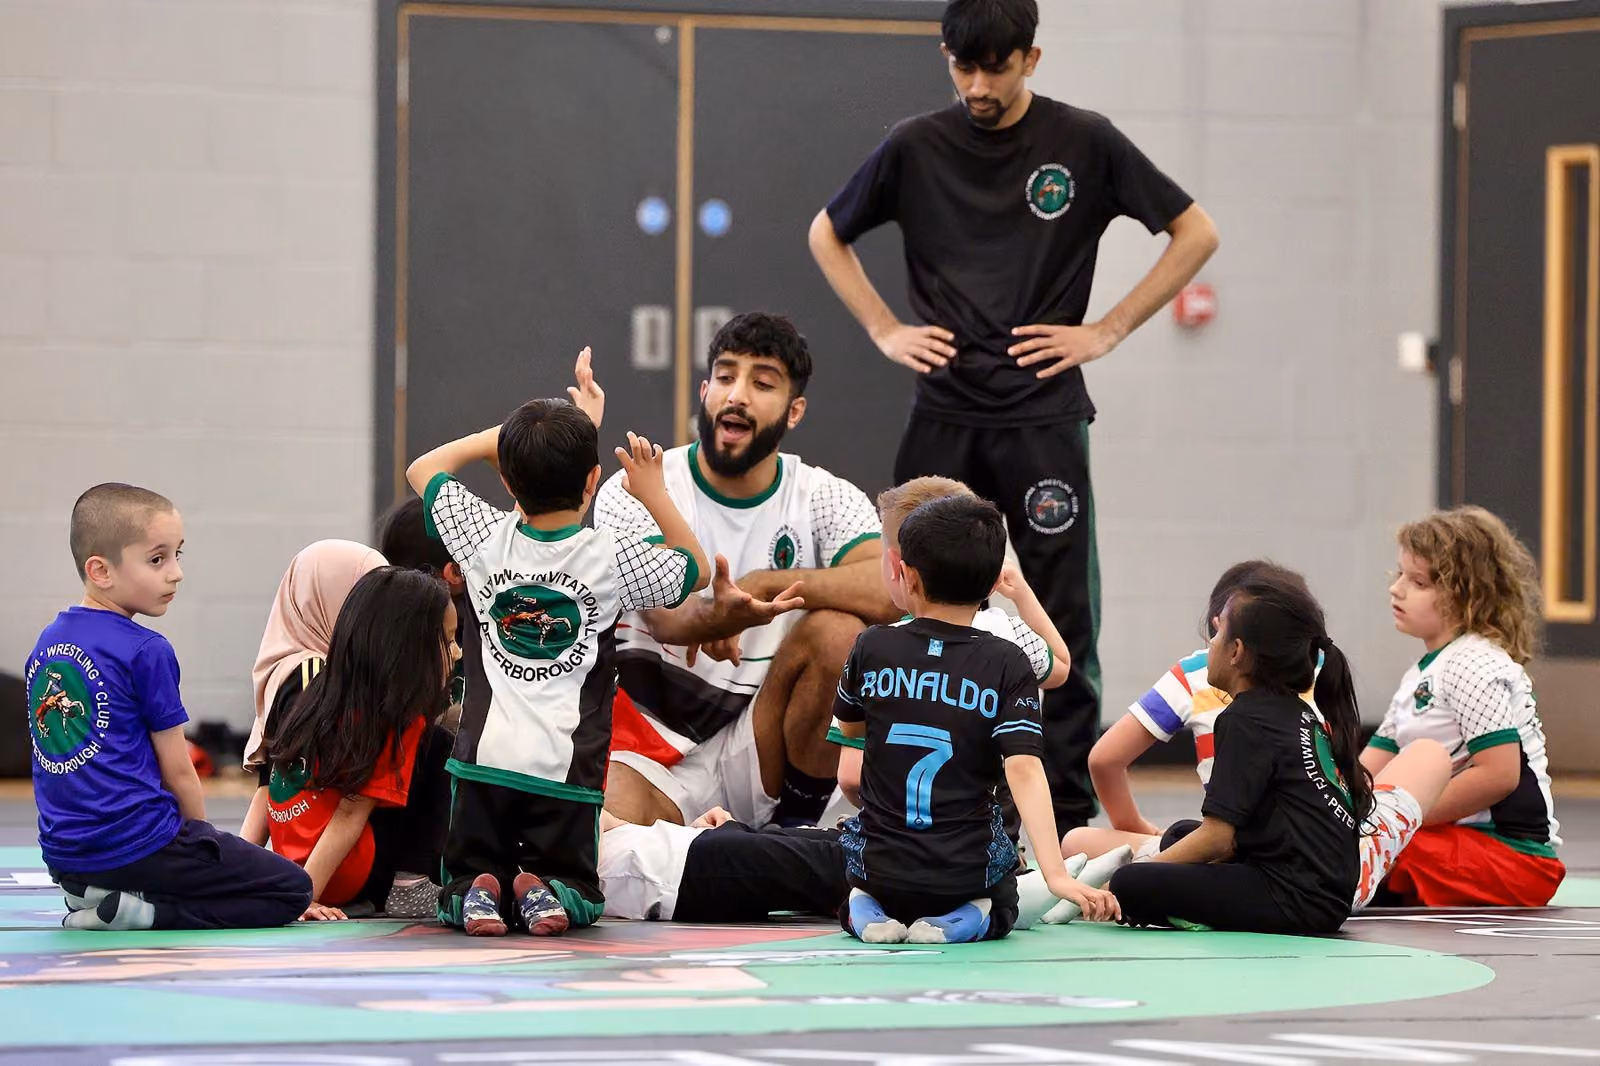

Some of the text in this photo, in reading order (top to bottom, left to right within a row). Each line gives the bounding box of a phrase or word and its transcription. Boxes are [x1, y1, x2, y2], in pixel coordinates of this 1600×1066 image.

[530, 570, 600, 637] INVITATIONAL
[46, 643, 111, 729] WRESTLING CLUB
[860, 666, 1000, 719] RONALDO
[32, 737, 102, 775] ETERBOROUGH
[884, 722, 954, 831] 7
[1327, 796, 1356, 830] PETE
